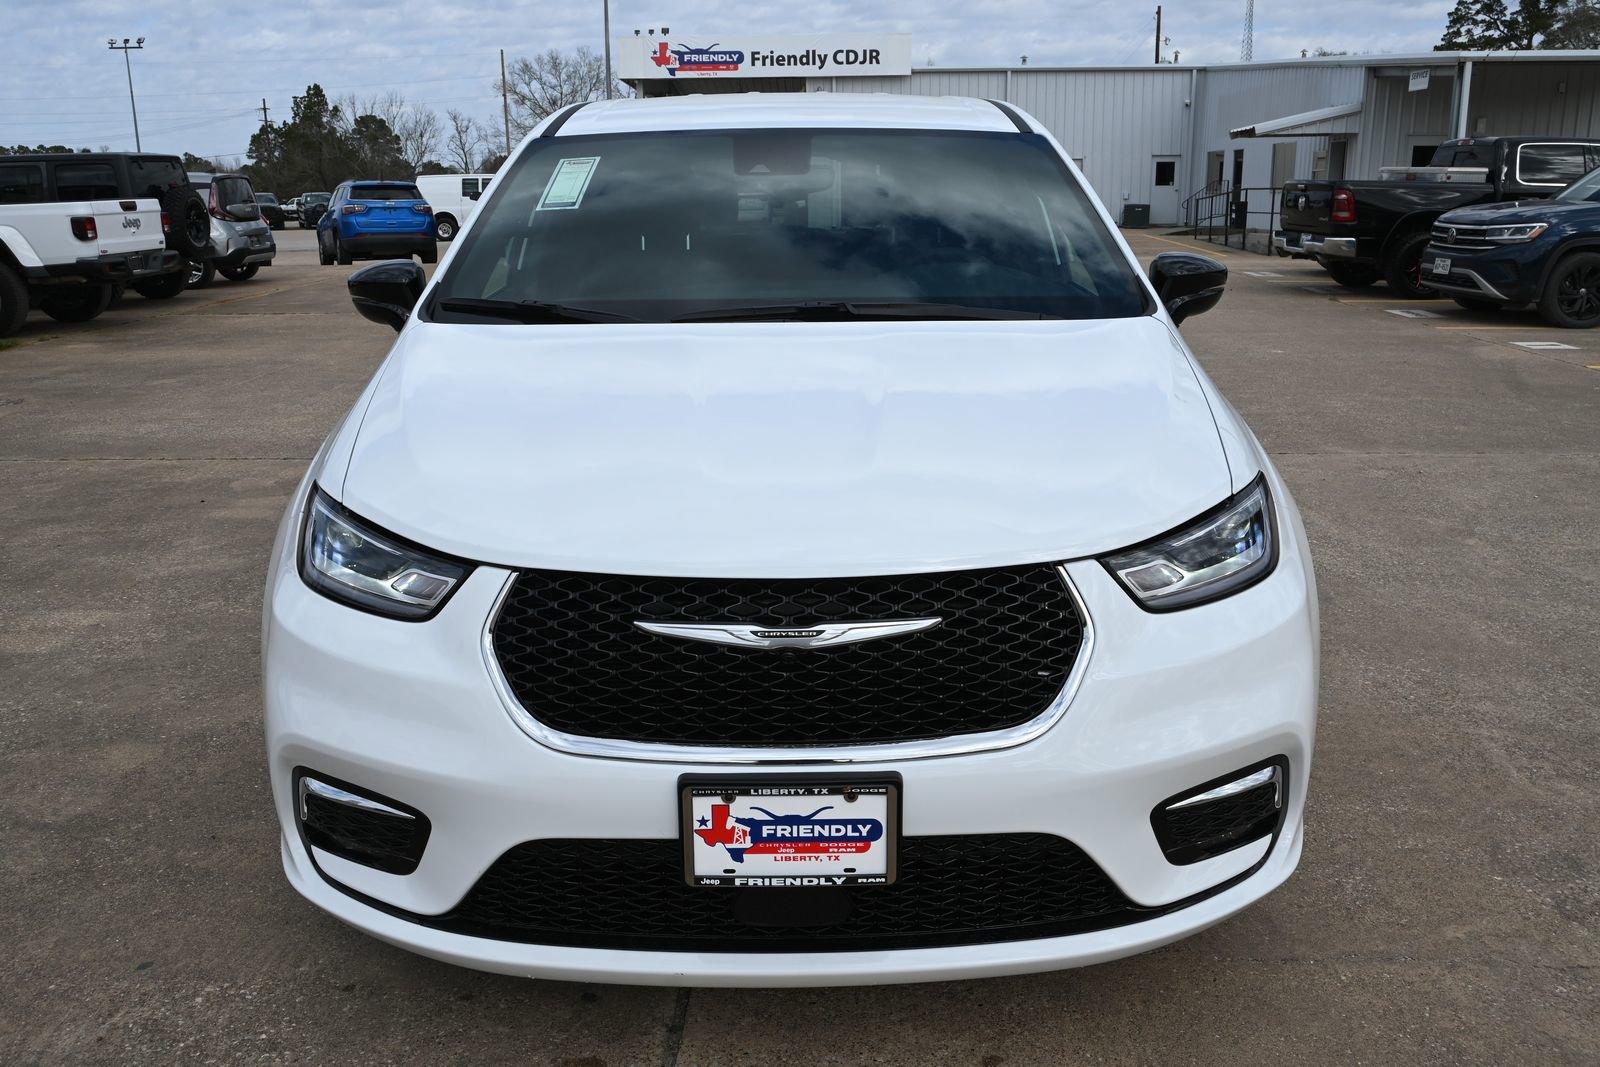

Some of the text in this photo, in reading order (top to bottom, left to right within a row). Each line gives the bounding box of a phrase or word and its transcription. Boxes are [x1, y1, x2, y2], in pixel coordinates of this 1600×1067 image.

[684, 54, 739, 62] FRIENDLY
[751, 49, 880, 69] Friendly CDJR
[122, 216, 141, 230] Jeep
[762, 825, 872, 837] FRIENDLY
[700, 878, 720, 886] Jeep
[734, 877, 847, 886] FRIENDLY
